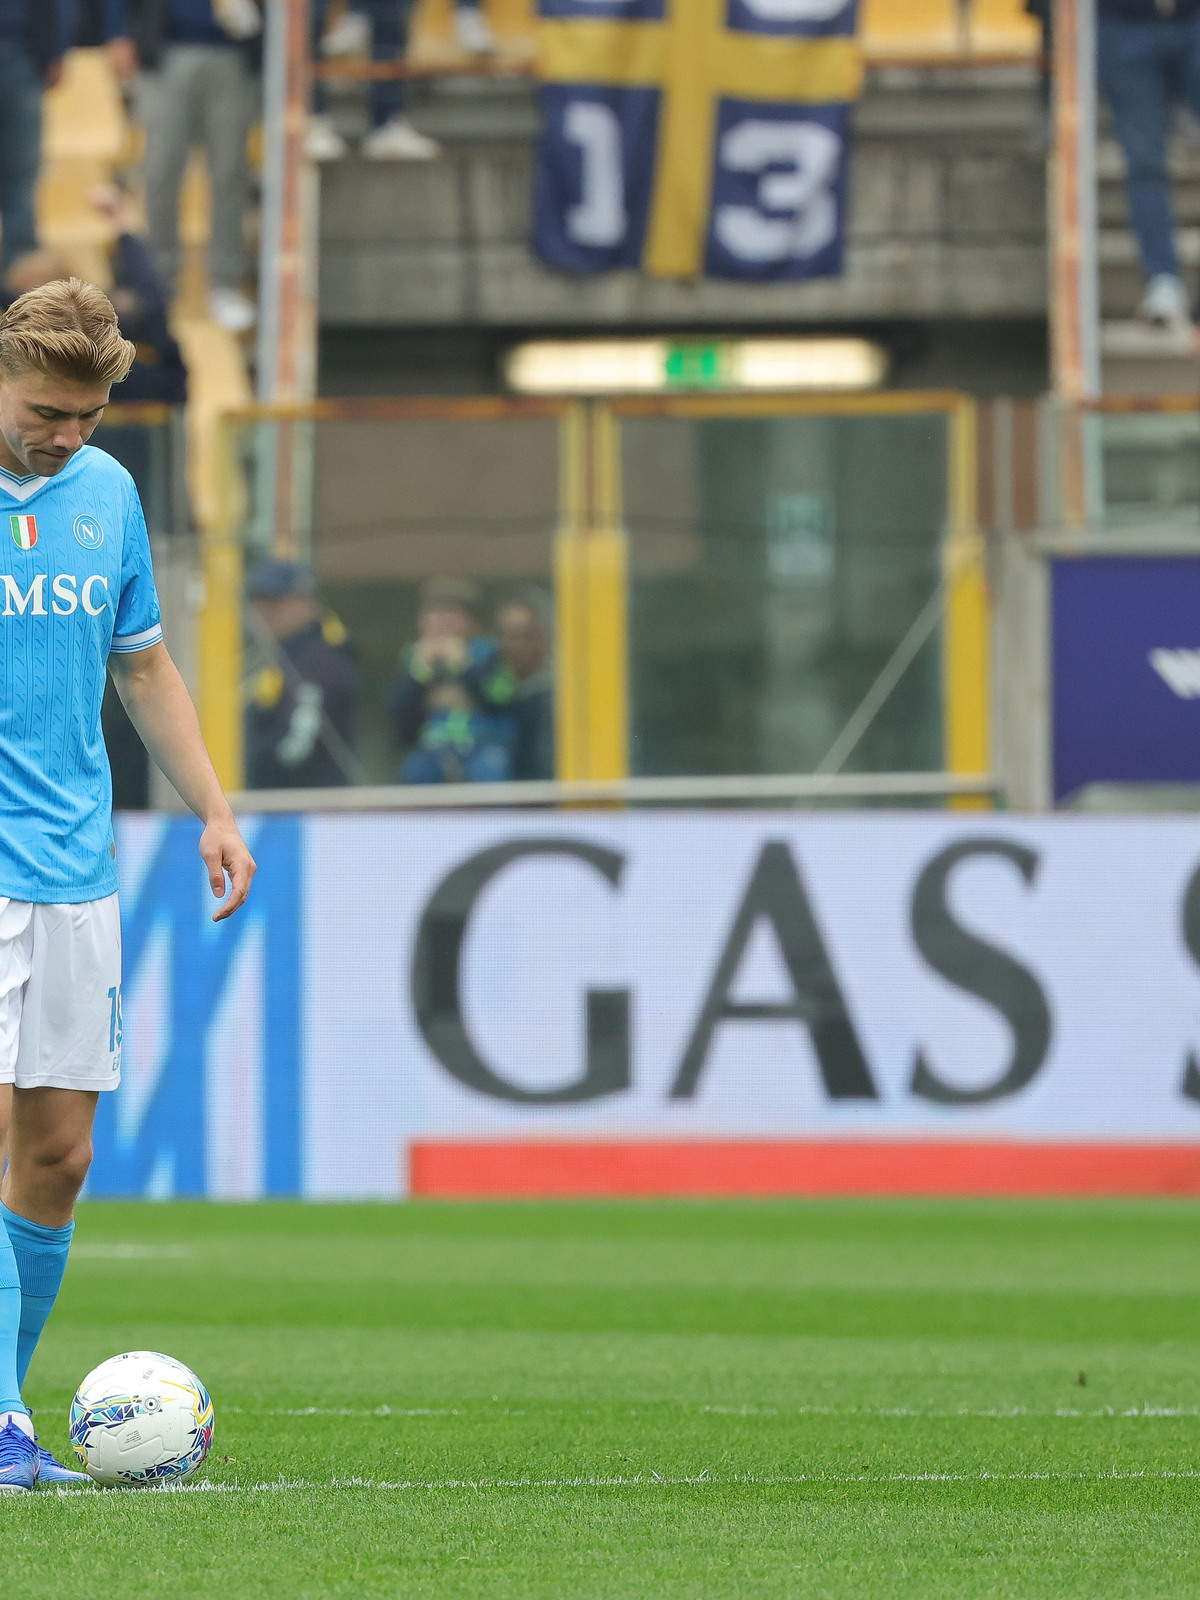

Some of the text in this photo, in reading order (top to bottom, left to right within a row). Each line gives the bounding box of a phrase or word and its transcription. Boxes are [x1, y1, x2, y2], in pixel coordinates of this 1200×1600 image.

[563, 99, 843, 262] 1 3
[80, 524, 95, 540] N
[0, 574, 109, 616] MSC
[408, 832, 1058, 1107] GAS
